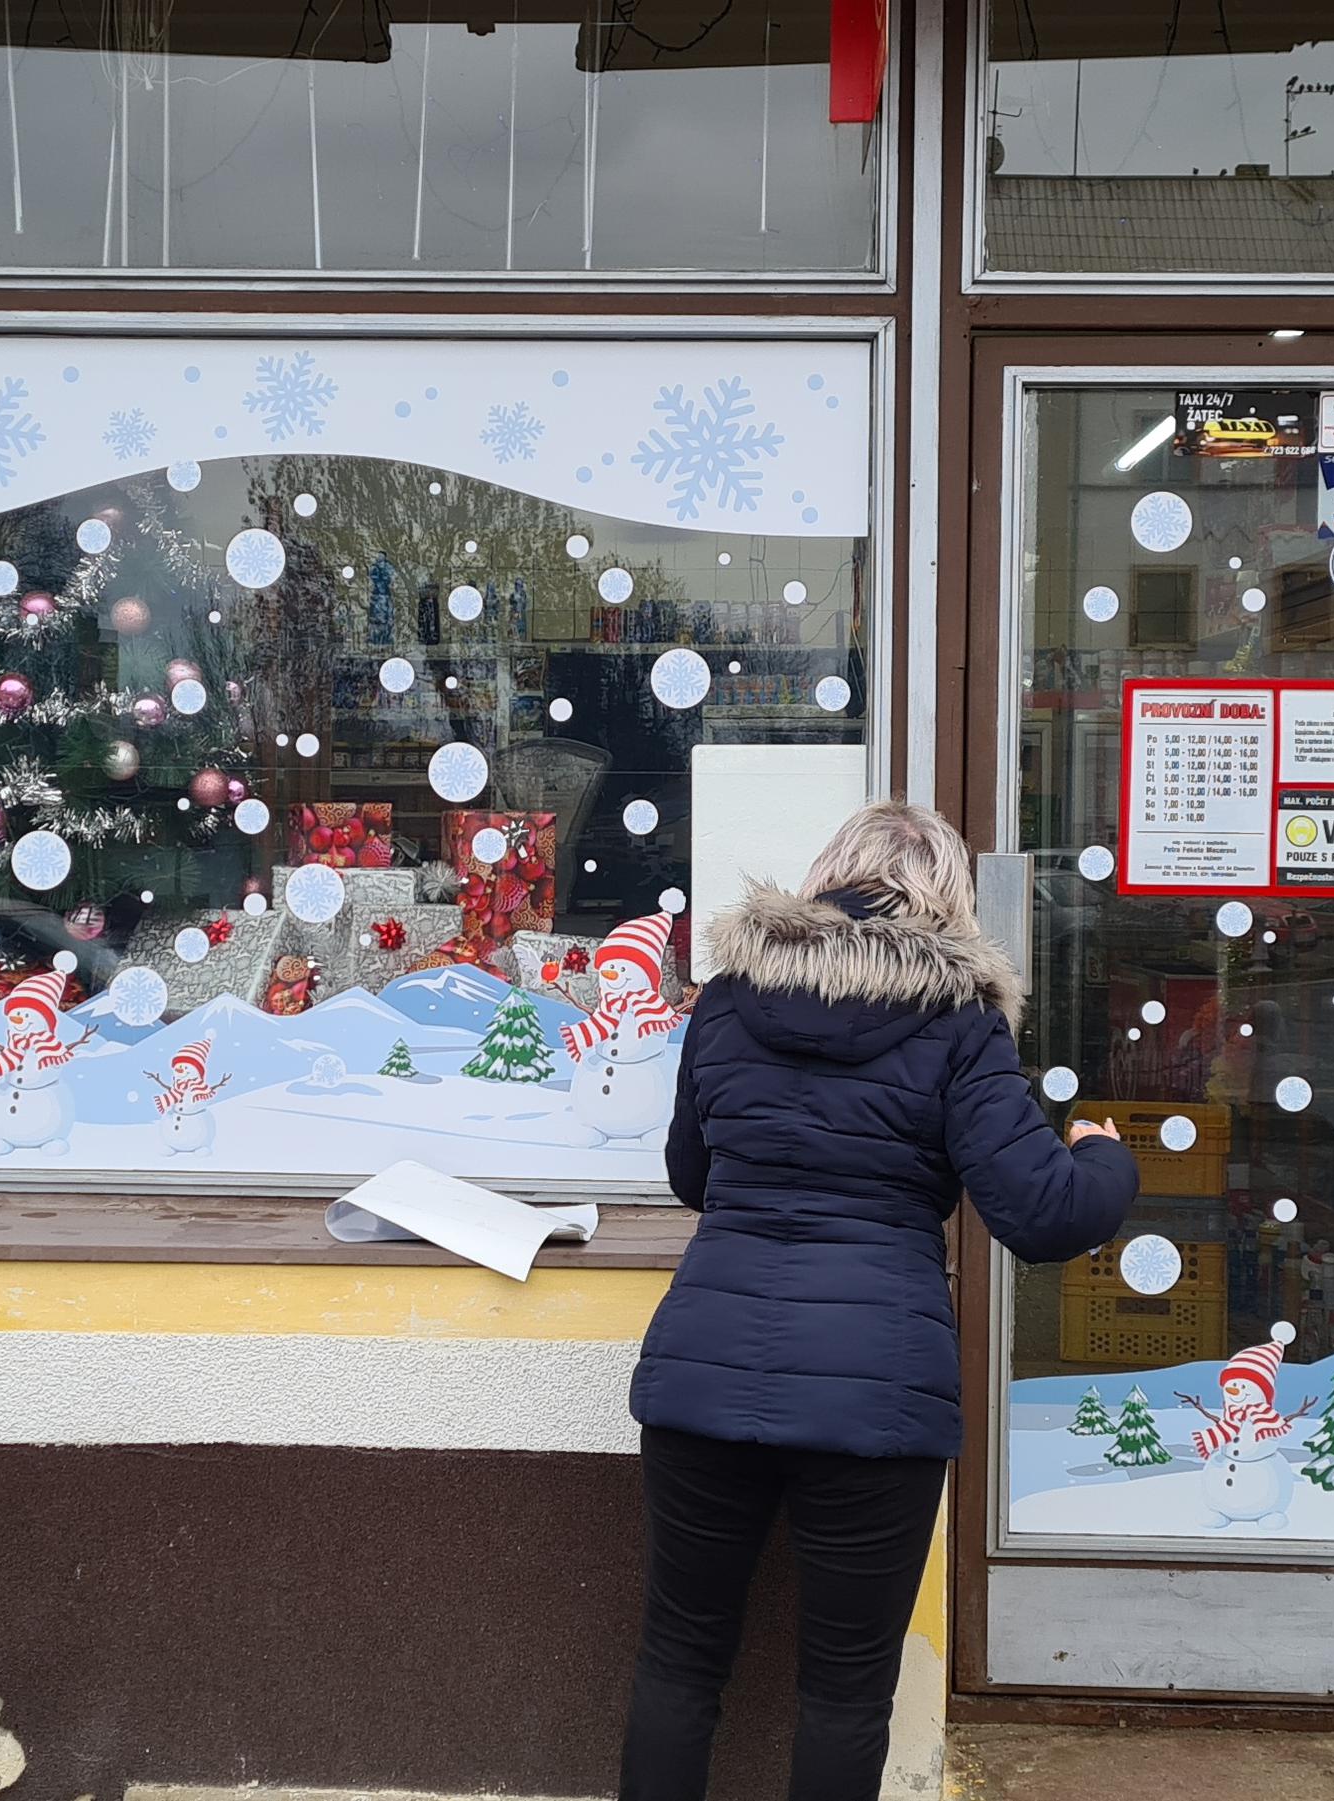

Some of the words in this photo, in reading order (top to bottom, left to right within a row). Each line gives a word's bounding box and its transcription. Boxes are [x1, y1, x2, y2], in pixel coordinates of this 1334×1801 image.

[1178, 393, 1204, 406] TAXI
[1207, 393, 1234, 407] 24/7
[1187, 407, 1223, 422] ŽATEC
[1224, 421, 1268, 432] TAXI
[1141, 699, 1217, 718] PROVOZNÍ
[1220, 703, 1266, 719] DOBA:
[1146, 734, 1157, 743] Po
[1145, 760, 1154, 769] St
[1145, 786, 1156, 795] Pá
[1283, 797, 1303, 805] MAX.
[1305, 796, 1329, 806] POČET
[1286, 851, 1318, 862] POUZE
[1321, 852, 1328, 862] S
